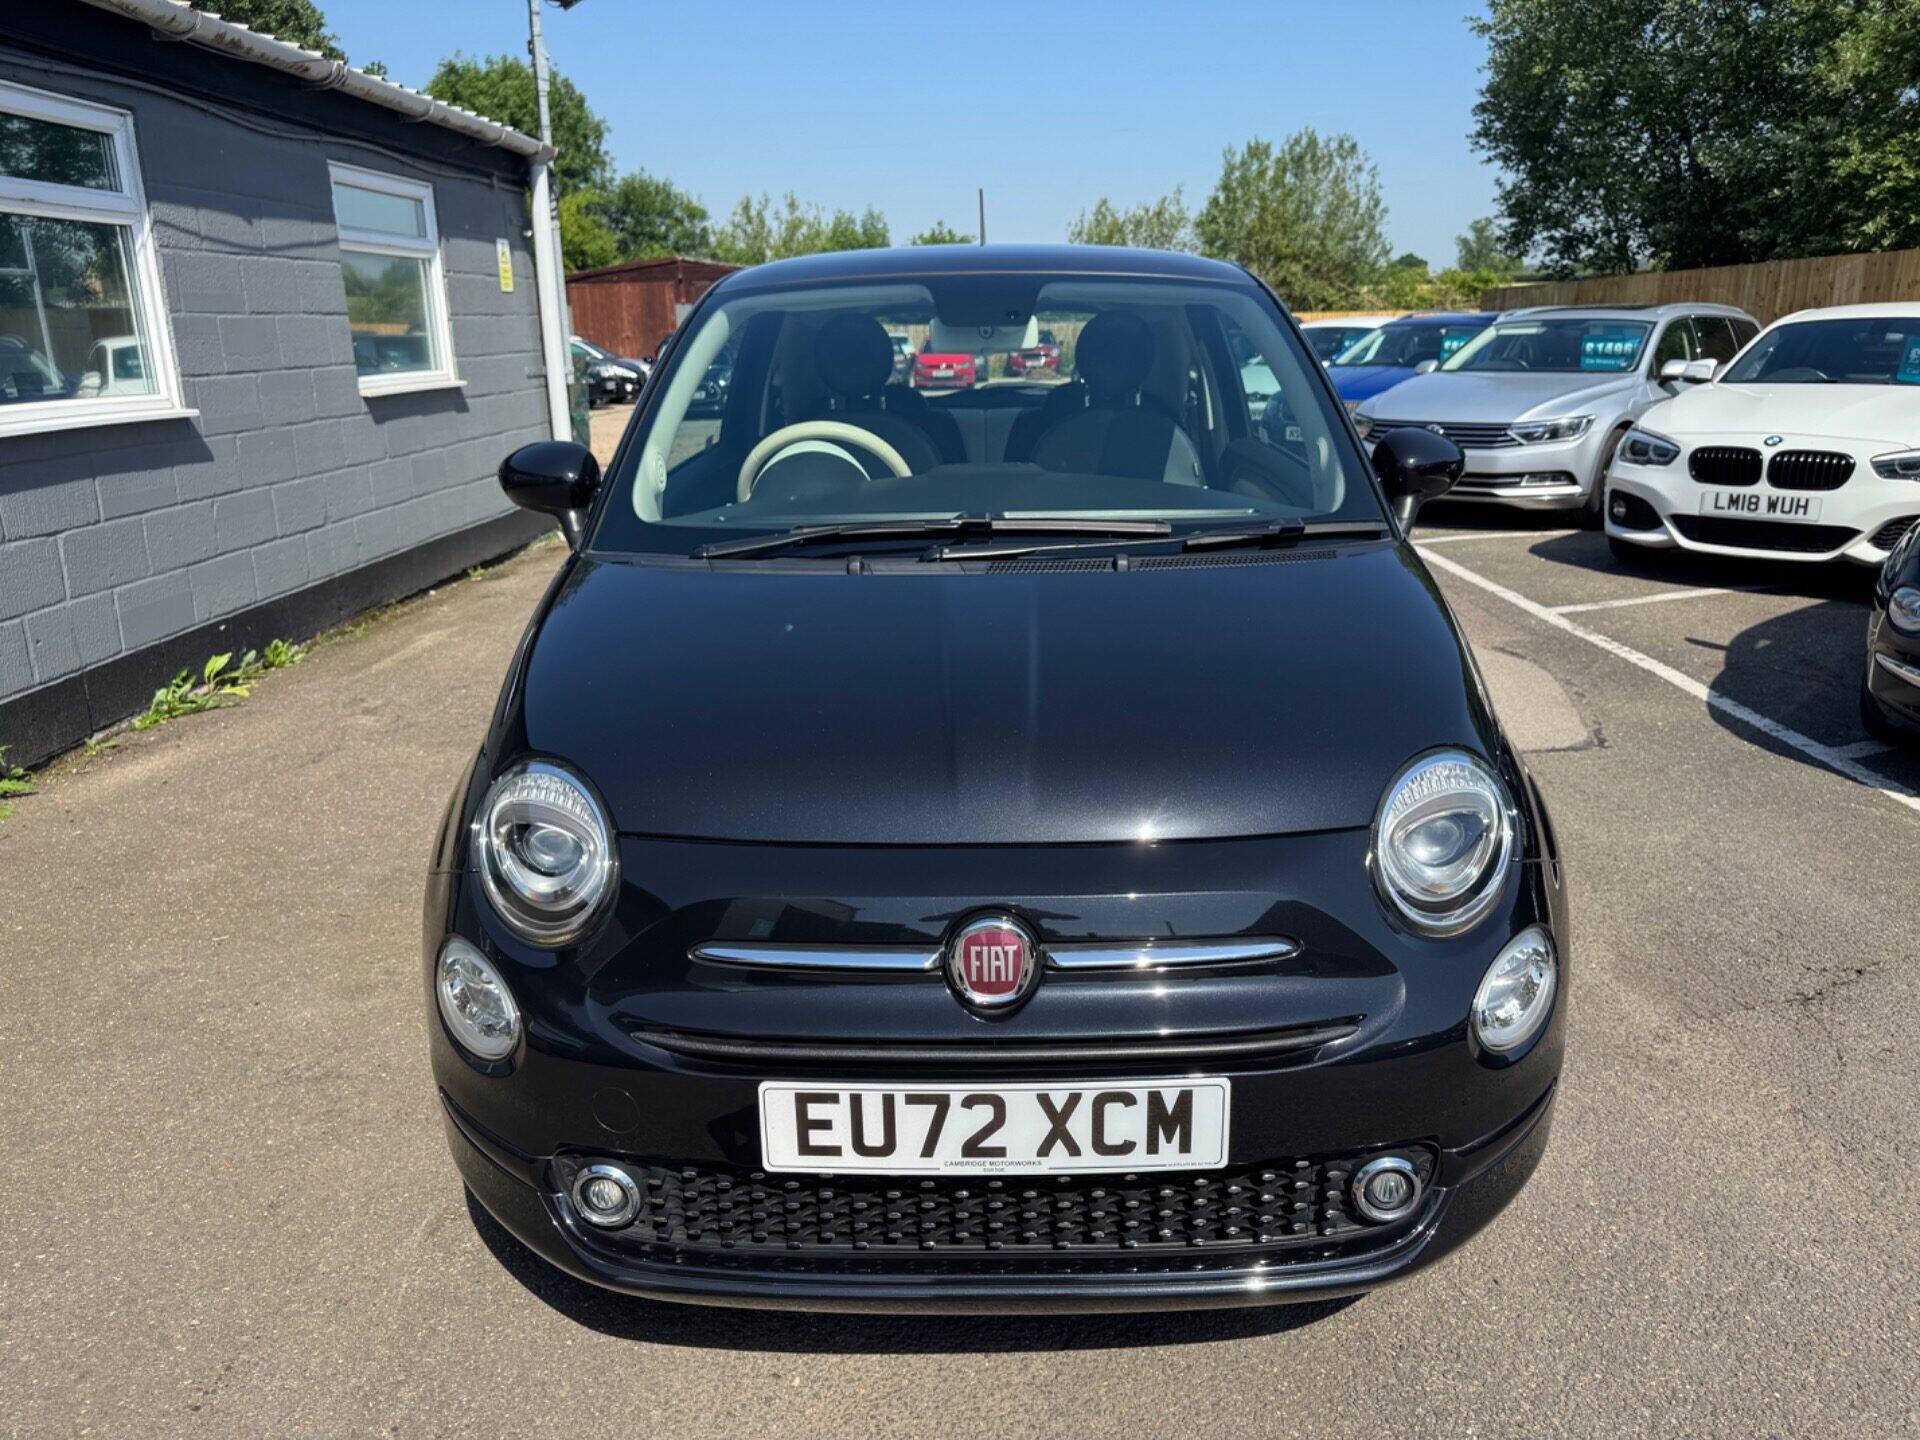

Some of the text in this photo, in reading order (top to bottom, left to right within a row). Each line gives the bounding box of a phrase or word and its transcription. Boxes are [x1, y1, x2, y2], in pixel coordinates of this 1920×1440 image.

[1713, 492, 1810, 516] LM18 WUH
[969, 945, 1018, 983] FIAT
[794, 1089, 1194, 1158] EU72 XCM
